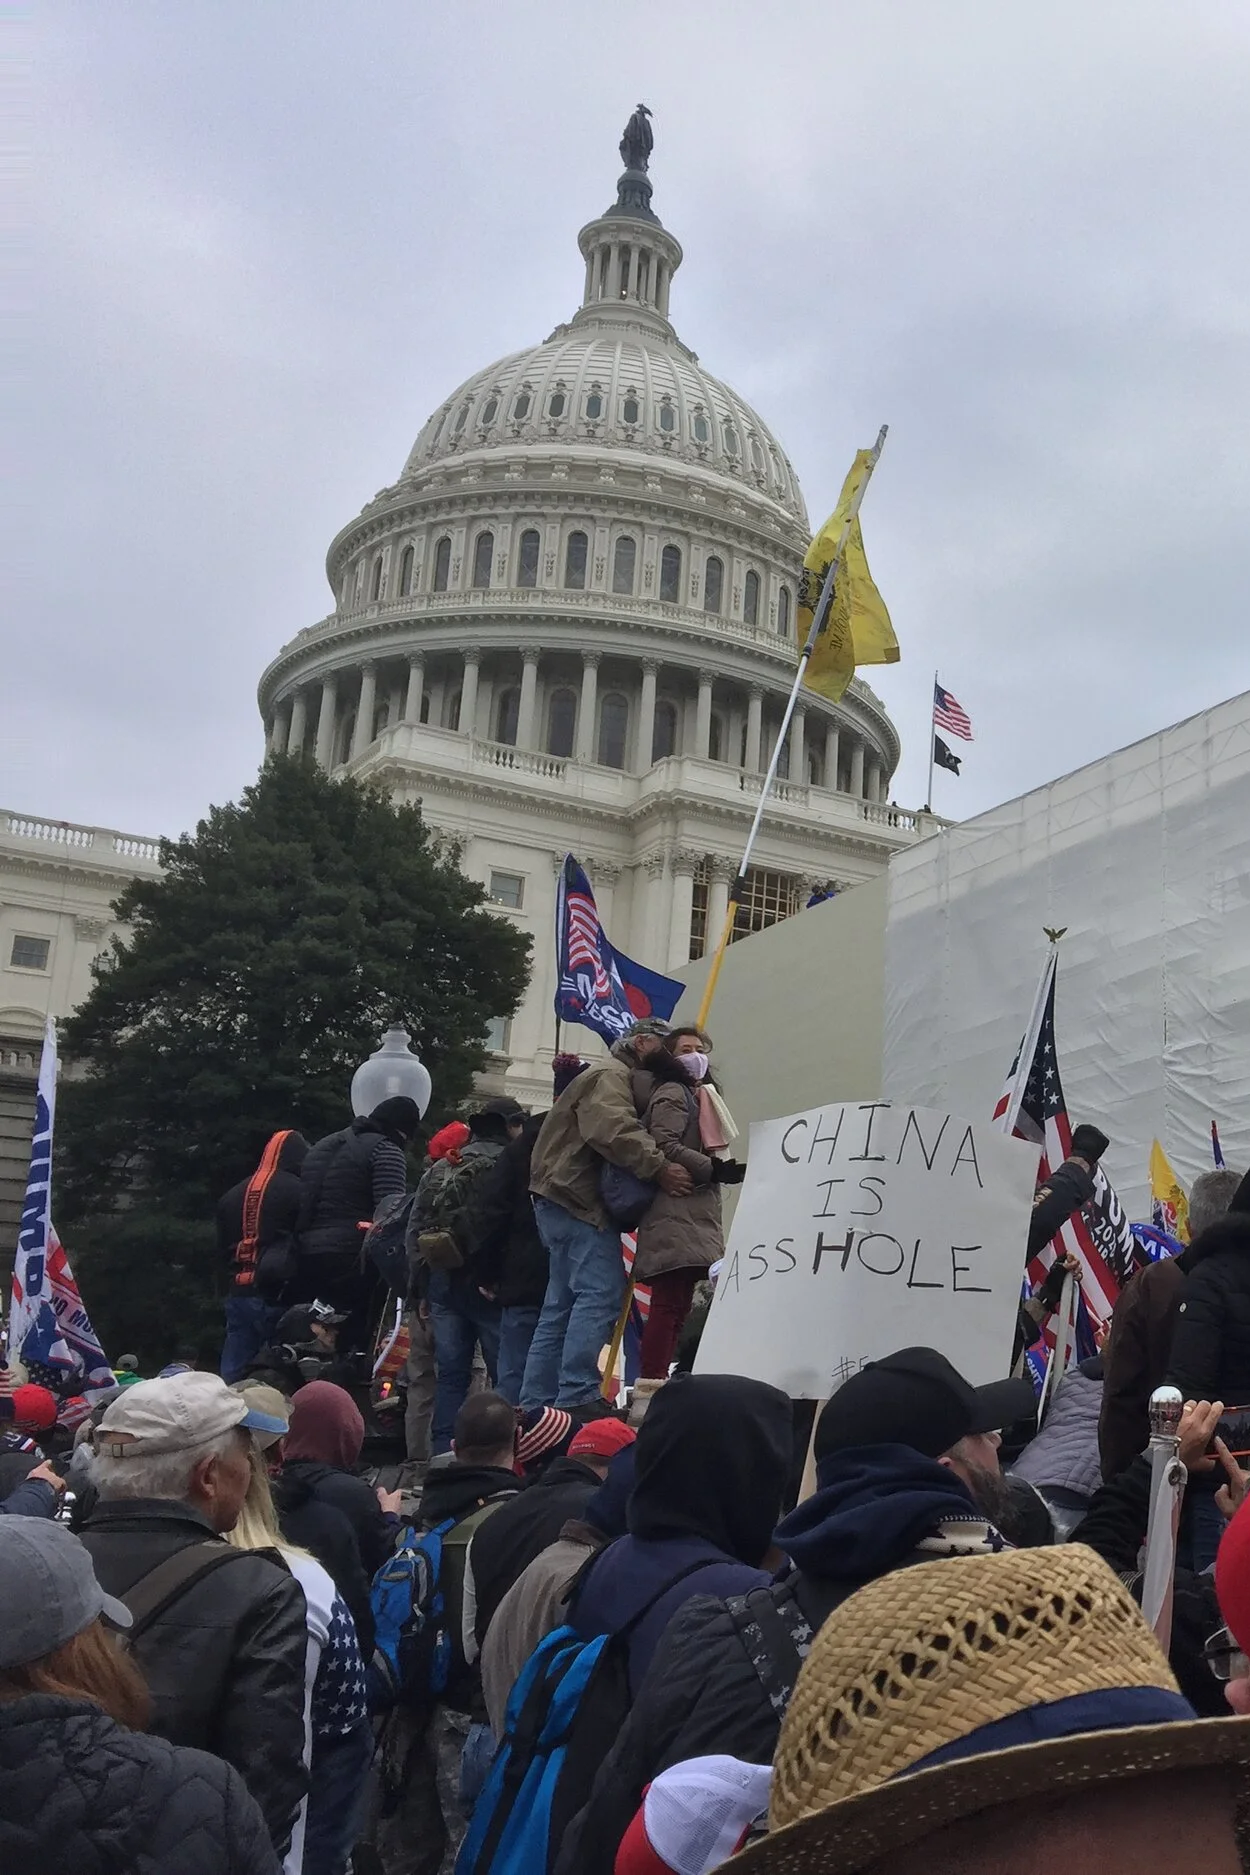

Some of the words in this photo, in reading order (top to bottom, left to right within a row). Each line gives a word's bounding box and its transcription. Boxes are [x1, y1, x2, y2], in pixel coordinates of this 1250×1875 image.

[780, 1103, 984, 1189] CHINA
[812, 1176, 887, 1218] IS
[1092, 1164, 1135, 1276] RUM
[719, 1231, 992, 1301] ASSHOLE
[68, 1309, 96, 1336] MO
